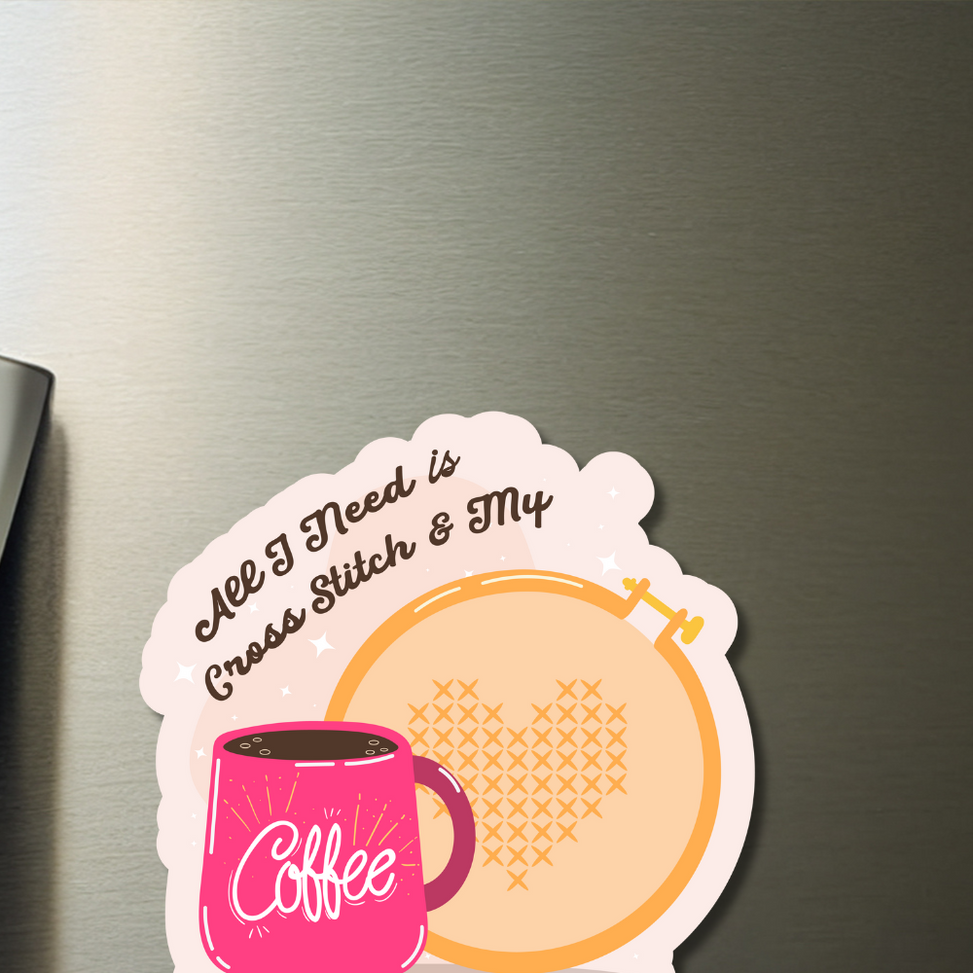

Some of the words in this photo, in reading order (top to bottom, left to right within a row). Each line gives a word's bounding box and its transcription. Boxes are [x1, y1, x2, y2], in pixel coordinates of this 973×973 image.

[195, 559, 266, 643] All
[264, 532, 294, 577] I
[299, 465, 417, 553] Need
[428, 449, 461, 484] is
[204, 607, 306, 702] Cross
[310, 533, 417, 615] Stitch
[428, 511, 454, 547] &
[466, 486, 554, 534] My
[232, 820, 397, 923] Coffee
